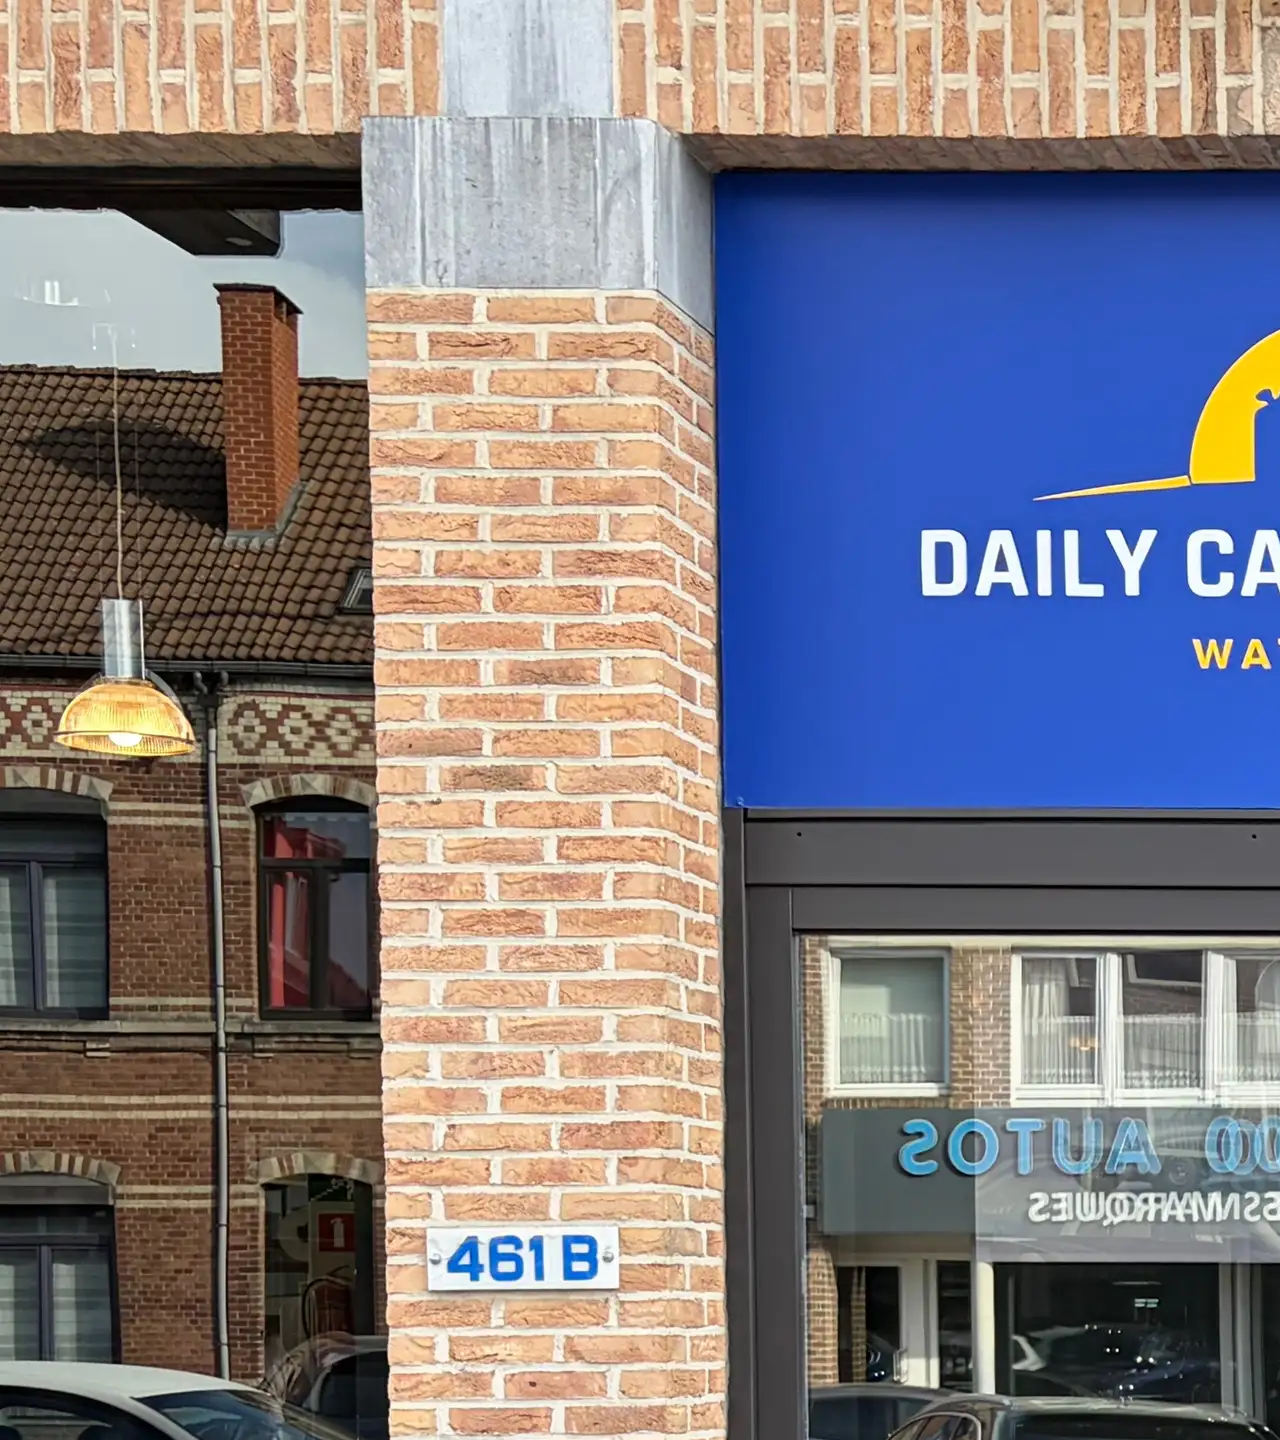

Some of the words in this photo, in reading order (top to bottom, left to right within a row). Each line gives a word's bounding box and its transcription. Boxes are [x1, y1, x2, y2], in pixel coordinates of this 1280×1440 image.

[920, 529, 1158, 598] DAILY
[446, 1234, 545, 1283] 461
[561, 1234, 599, 1282] B
